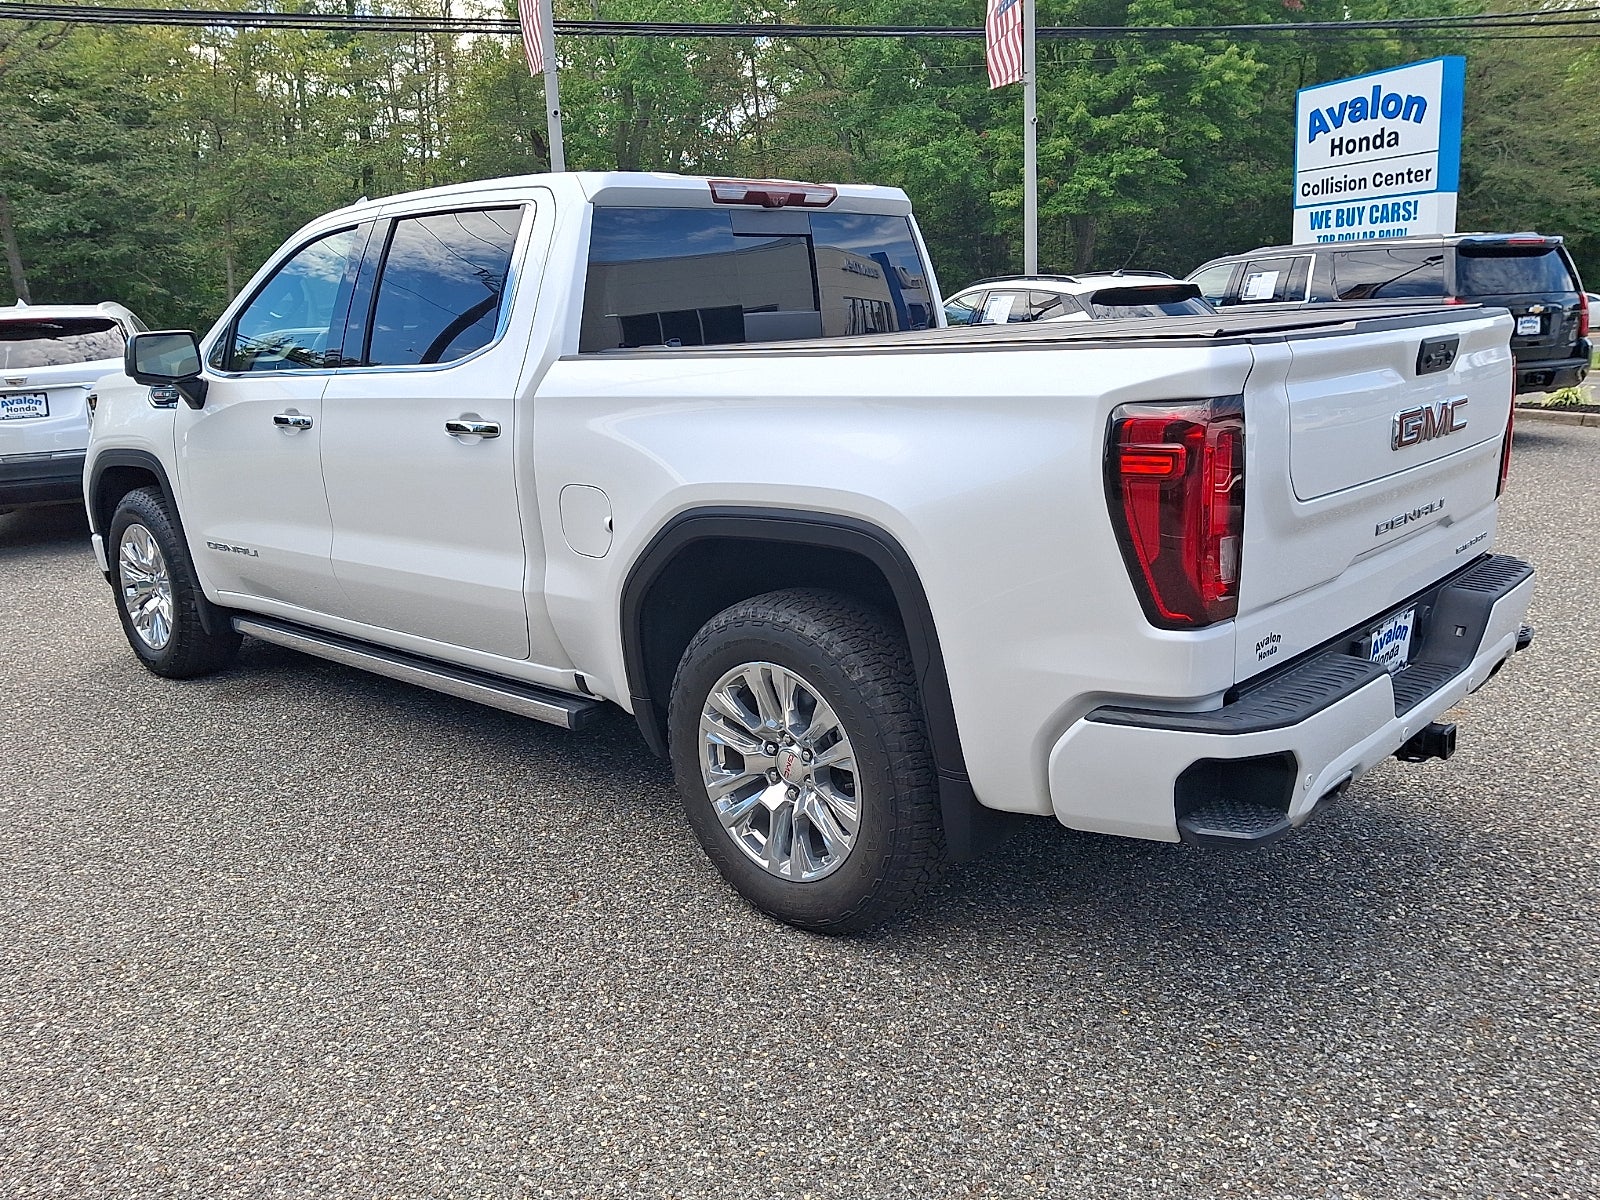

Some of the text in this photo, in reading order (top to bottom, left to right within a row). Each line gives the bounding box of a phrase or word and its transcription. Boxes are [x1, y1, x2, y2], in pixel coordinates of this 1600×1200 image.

[1308, 85, 1428, 143] Avalon
[1330, 127, 1400, 157] Honda
[1301, 167, 1432, 197] Collision Center
[1309, 199, 1419, 231] WE BUY CARS!
[1, 396, 43, 408] Avalon
[6, 405, 38, 413] Honda
[1391, 395, 1469, 451] GMC
[1375, 497, 1445, 536] DENALI
[206, 540, 260, 558] DENALI
[1255, 631, 1282, 655] Avalon
[1258, 645, 1278, 661] Honda
[1372, 620, 1409, 661] Avalon
[783, 752, 795, 779] GMC
